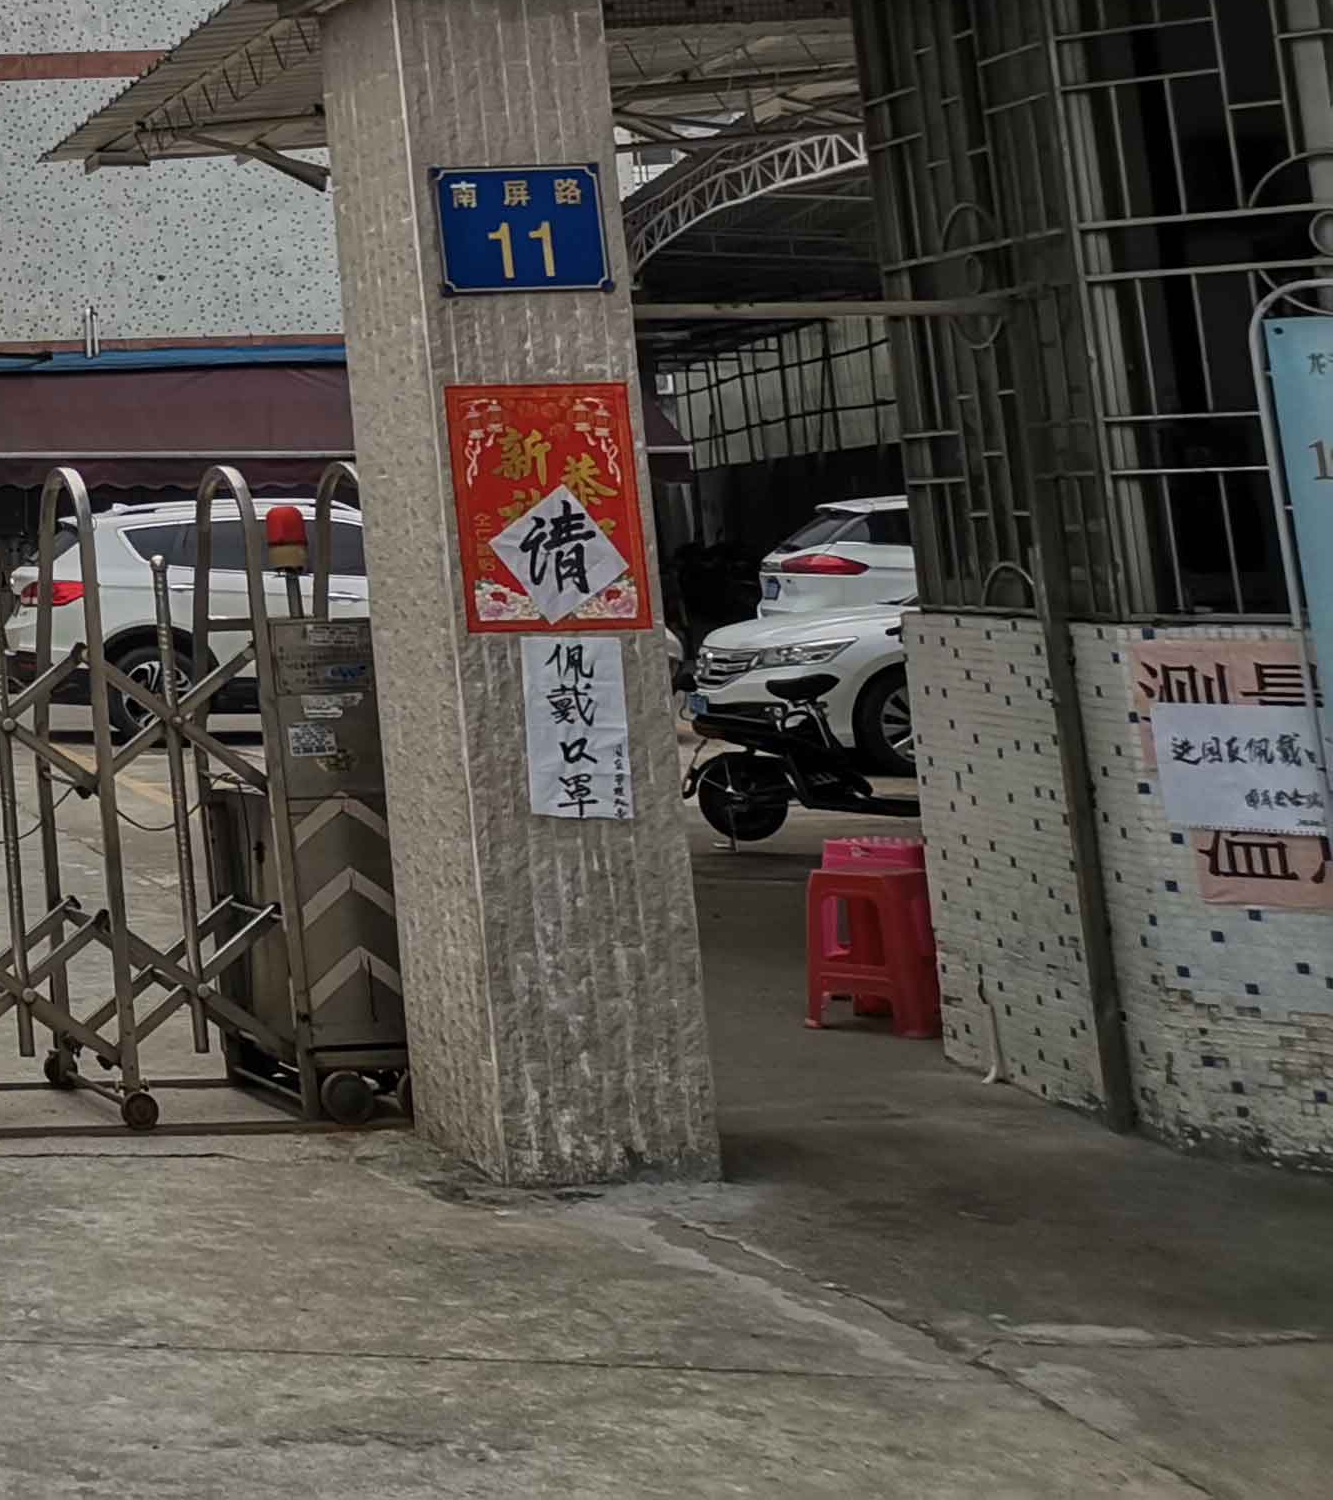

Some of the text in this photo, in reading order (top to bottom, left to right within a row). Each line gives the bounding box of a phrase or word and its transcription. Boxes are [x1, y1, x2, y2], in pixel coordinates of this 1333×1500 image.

[450, 178, 581, 208] 南屏路
[488, 221, 555, 279] 11
[519, 499, 596, 594] 请
[545, 643, 599, 819] 佩戴口罩
